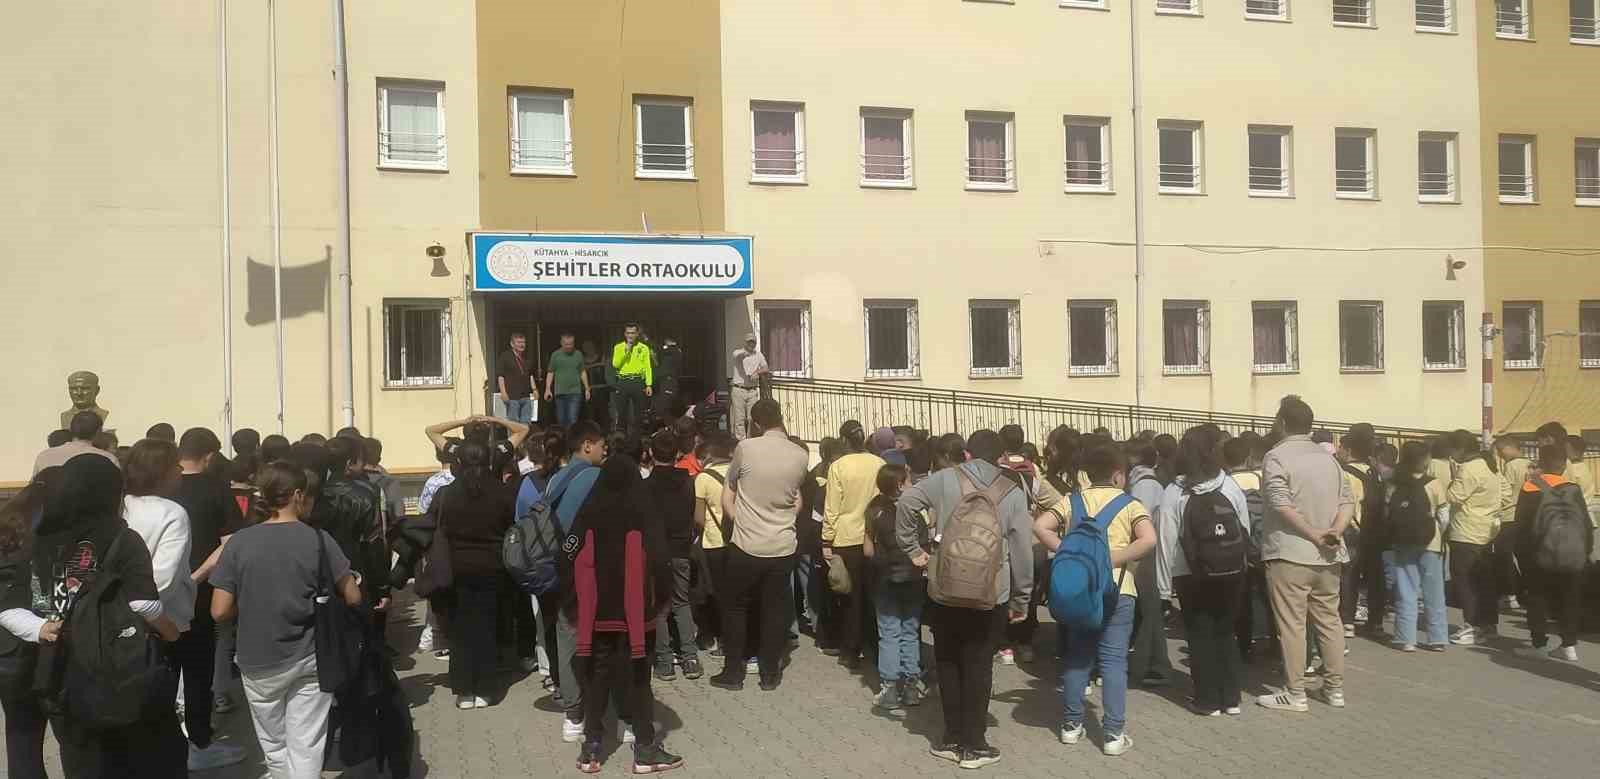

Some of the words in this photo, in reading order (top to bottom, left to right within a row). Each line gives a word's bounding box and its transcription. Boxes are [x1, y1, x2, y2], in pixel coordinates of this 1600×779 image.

[534, 248, 569, 257] KÜTAHYA
[575, 248, 609, 257] HİSARCIK
[533, 259, 621, 280] ŞEHİTLER
[626, 262, 736, 278] ORTAOKULU
